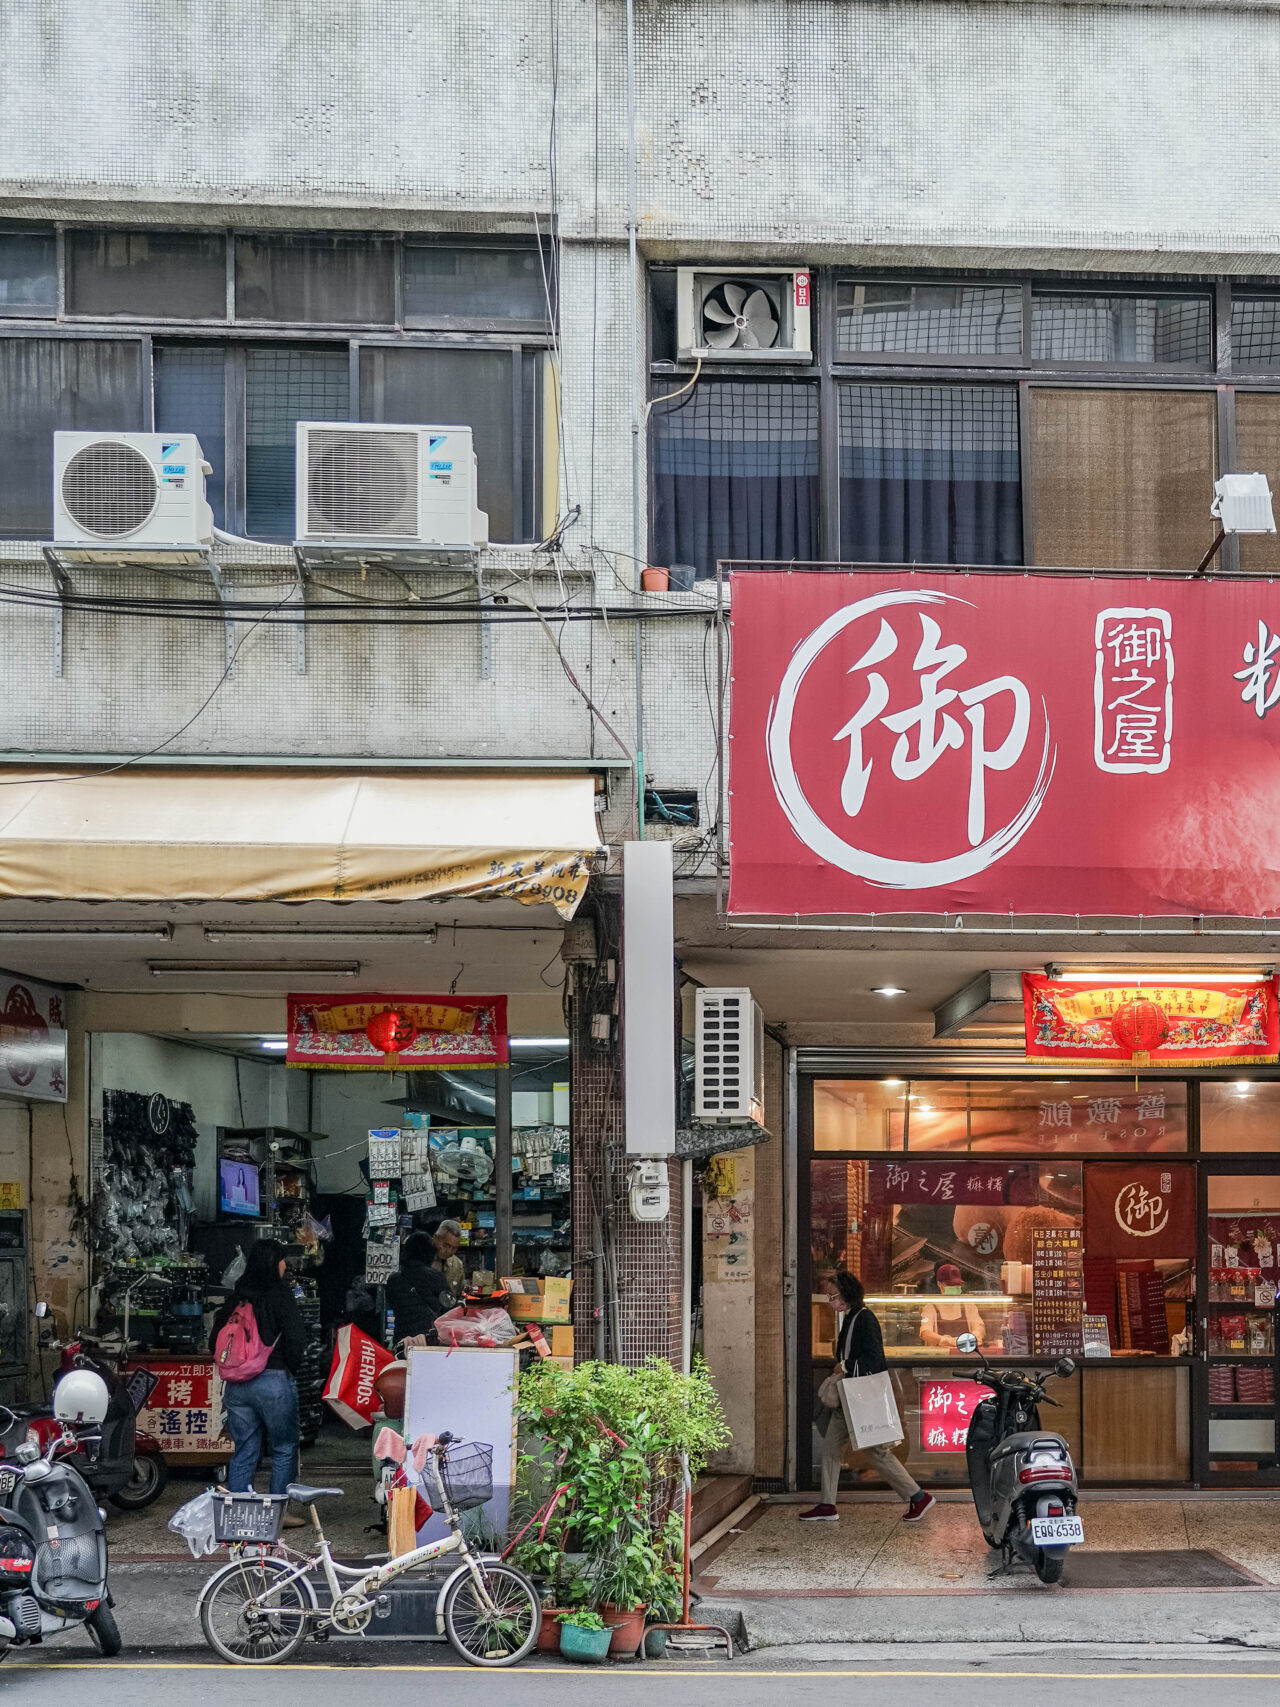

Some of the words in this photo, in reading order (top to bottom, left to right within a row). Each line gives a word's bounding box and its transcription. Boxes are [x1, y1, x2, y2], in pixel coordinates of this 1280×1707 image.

[799, 288, 806, 304] 日立
[1107, 623, 1162, 757] 御之屋
[832, 612, 1031, 847] 御
[886, 1165, 957, 1200] 御之屋
[1125, 1185, 1163, 1230] 御
[356, 1339, 376, 1405] THERMOS
[160, 1410, 208, 1435] 遙控
